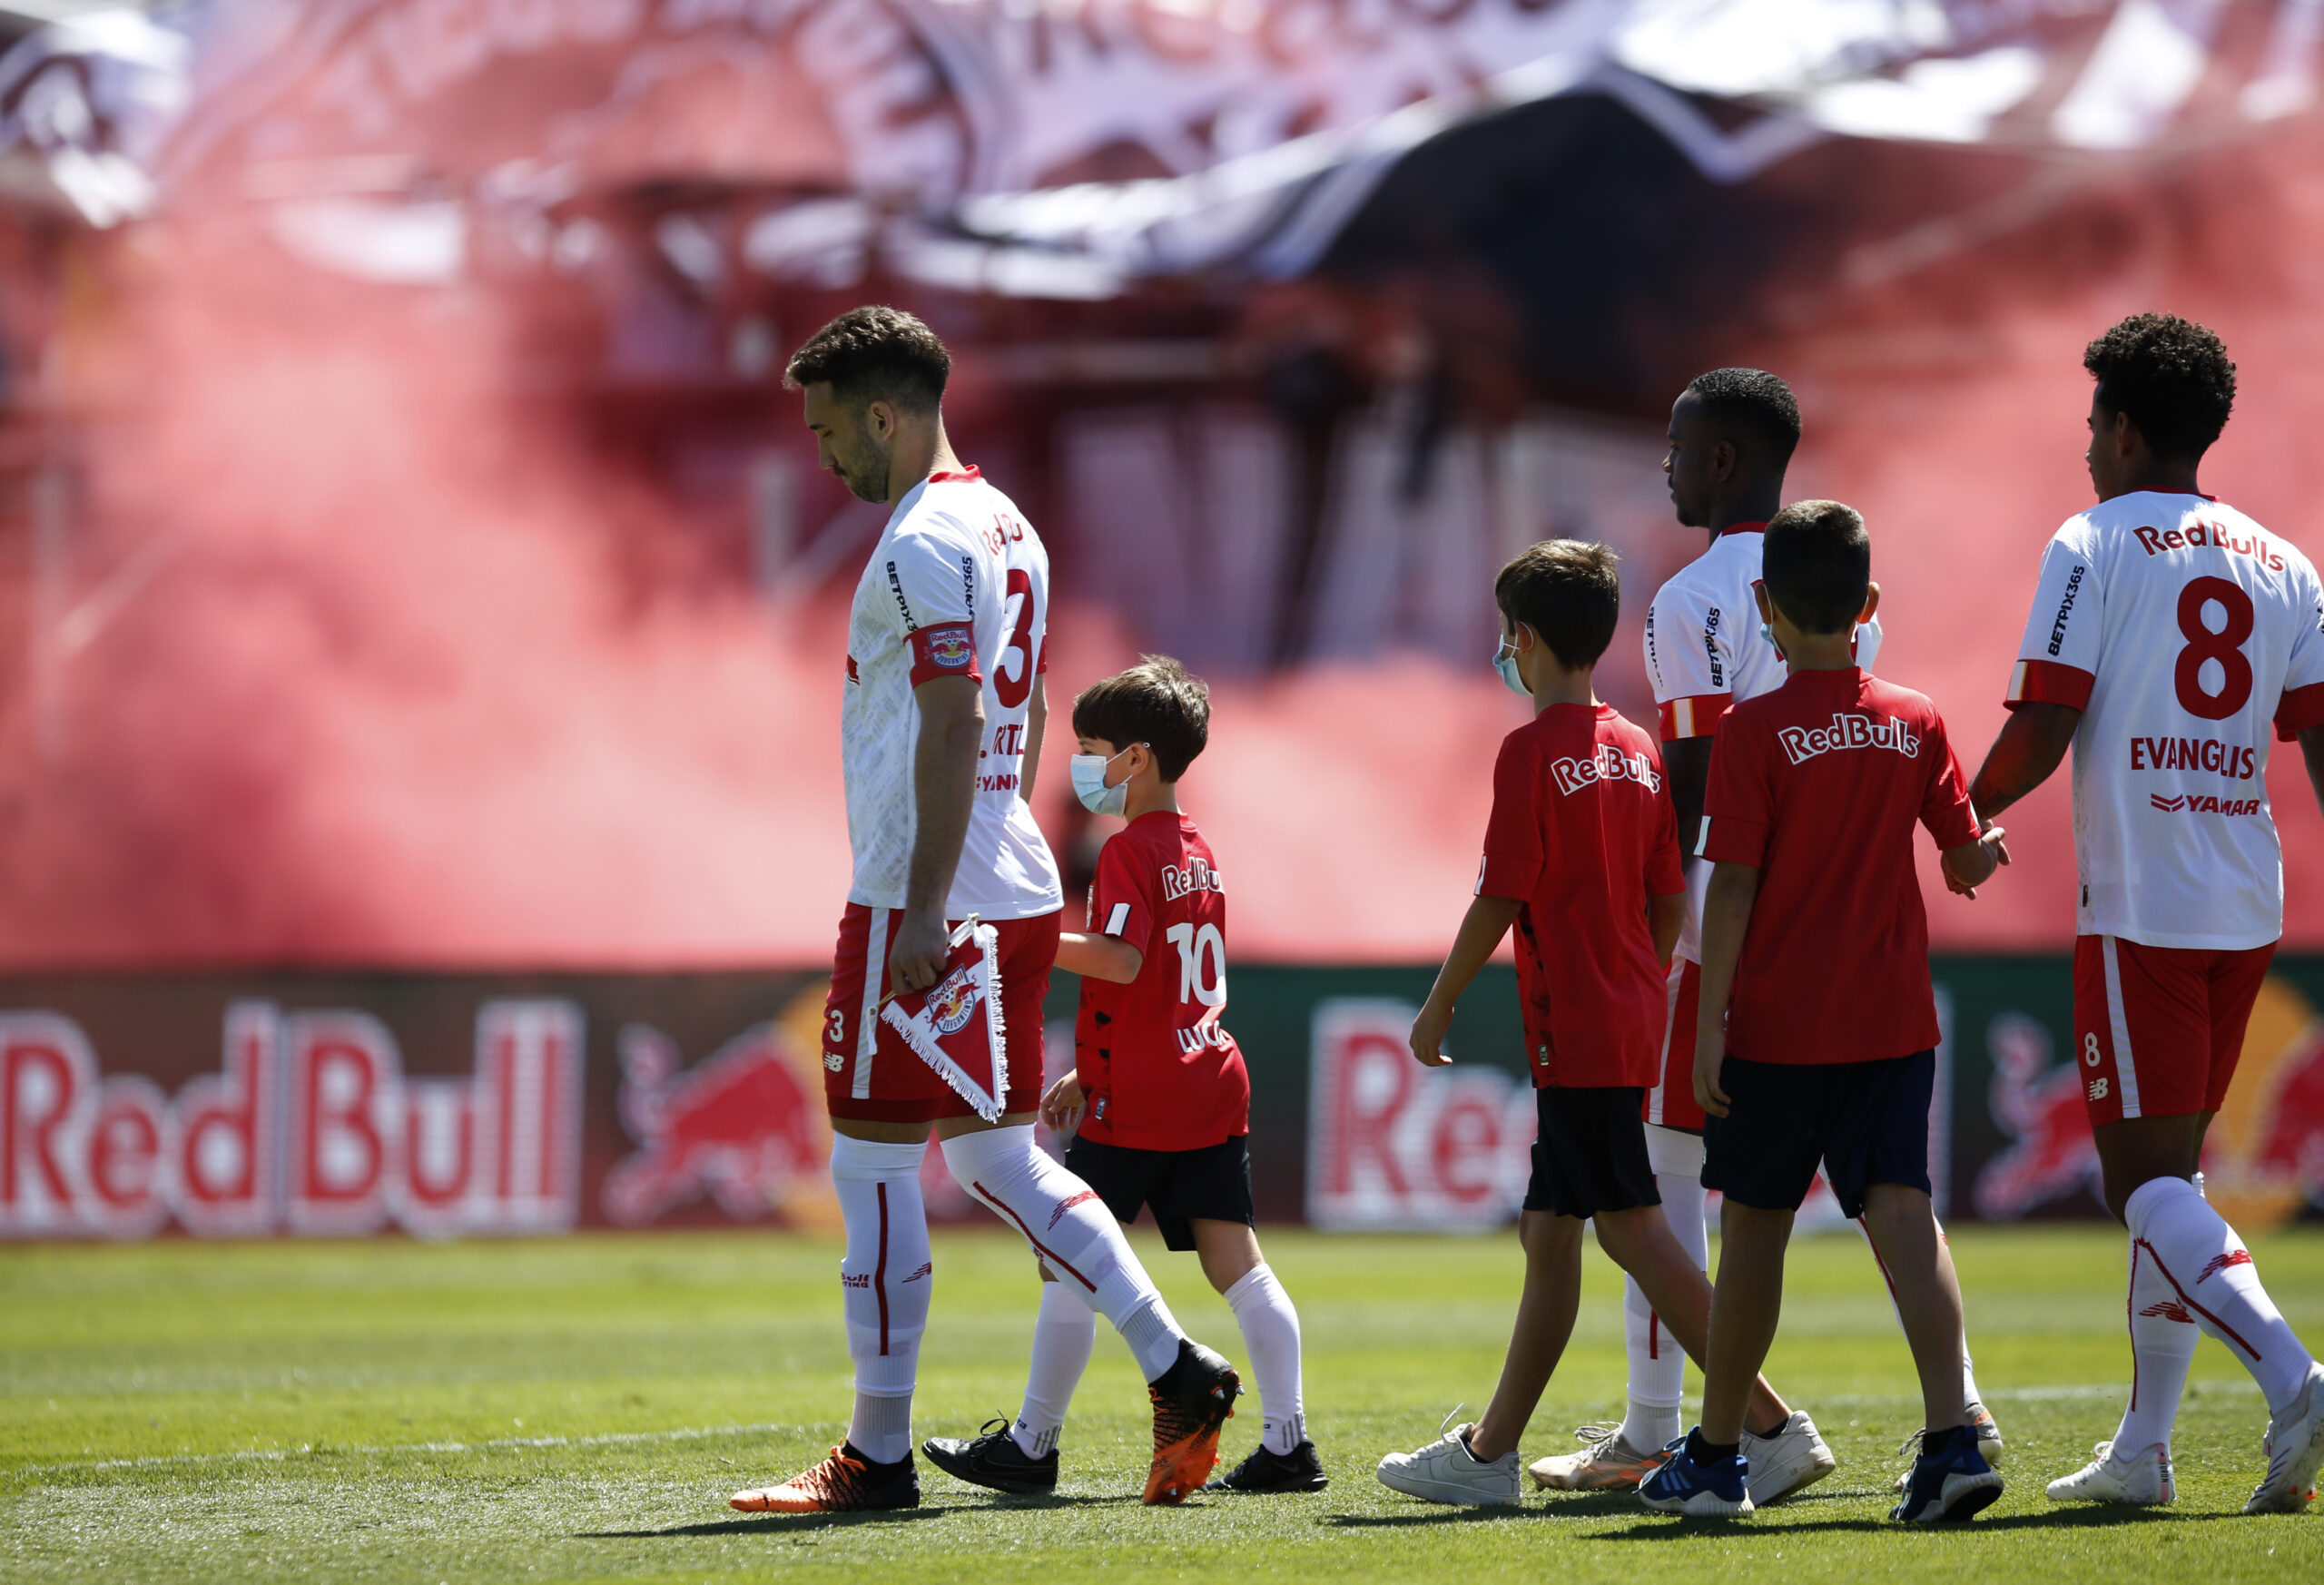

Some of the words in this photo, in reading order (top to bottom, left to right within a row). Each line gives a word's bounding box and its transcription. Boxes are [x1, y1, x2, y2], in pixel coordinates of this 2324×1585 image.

[993, 568, 1033, 708] 3
[2047, 566, 2085, 656] BETPIX365
[2174, 576, 2254, 720] 8
[1167, 922, 1226, 1007] 10
[829, 1009, 843, 1042] 3
[2084, 1032, 2101, 1067] 8
